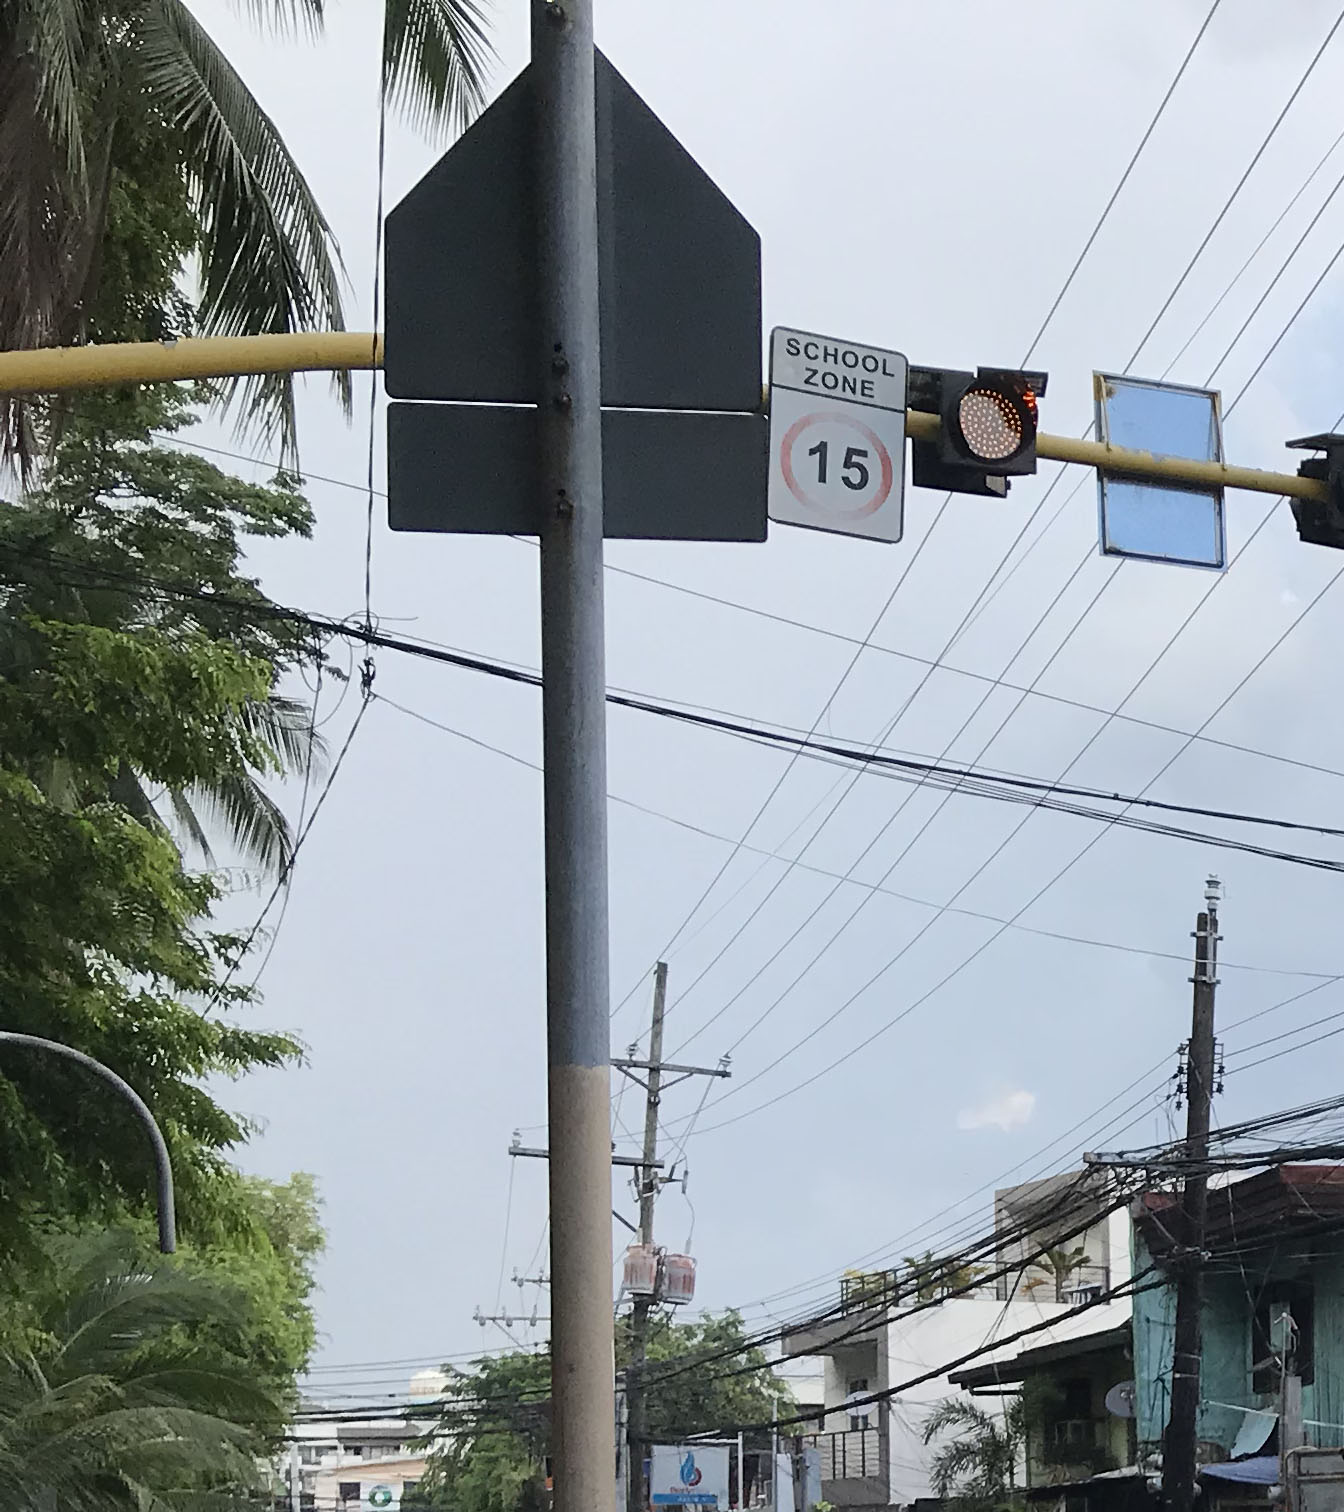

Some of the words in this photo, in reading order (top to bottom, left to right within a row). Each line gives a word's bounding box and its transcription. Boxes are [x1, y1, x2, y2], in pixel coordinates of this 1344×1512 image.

[785, 338, 895, 378] SCHOOL
[803, 367, 875, 398] ZONE
[808, 440, 870, 491] 15
